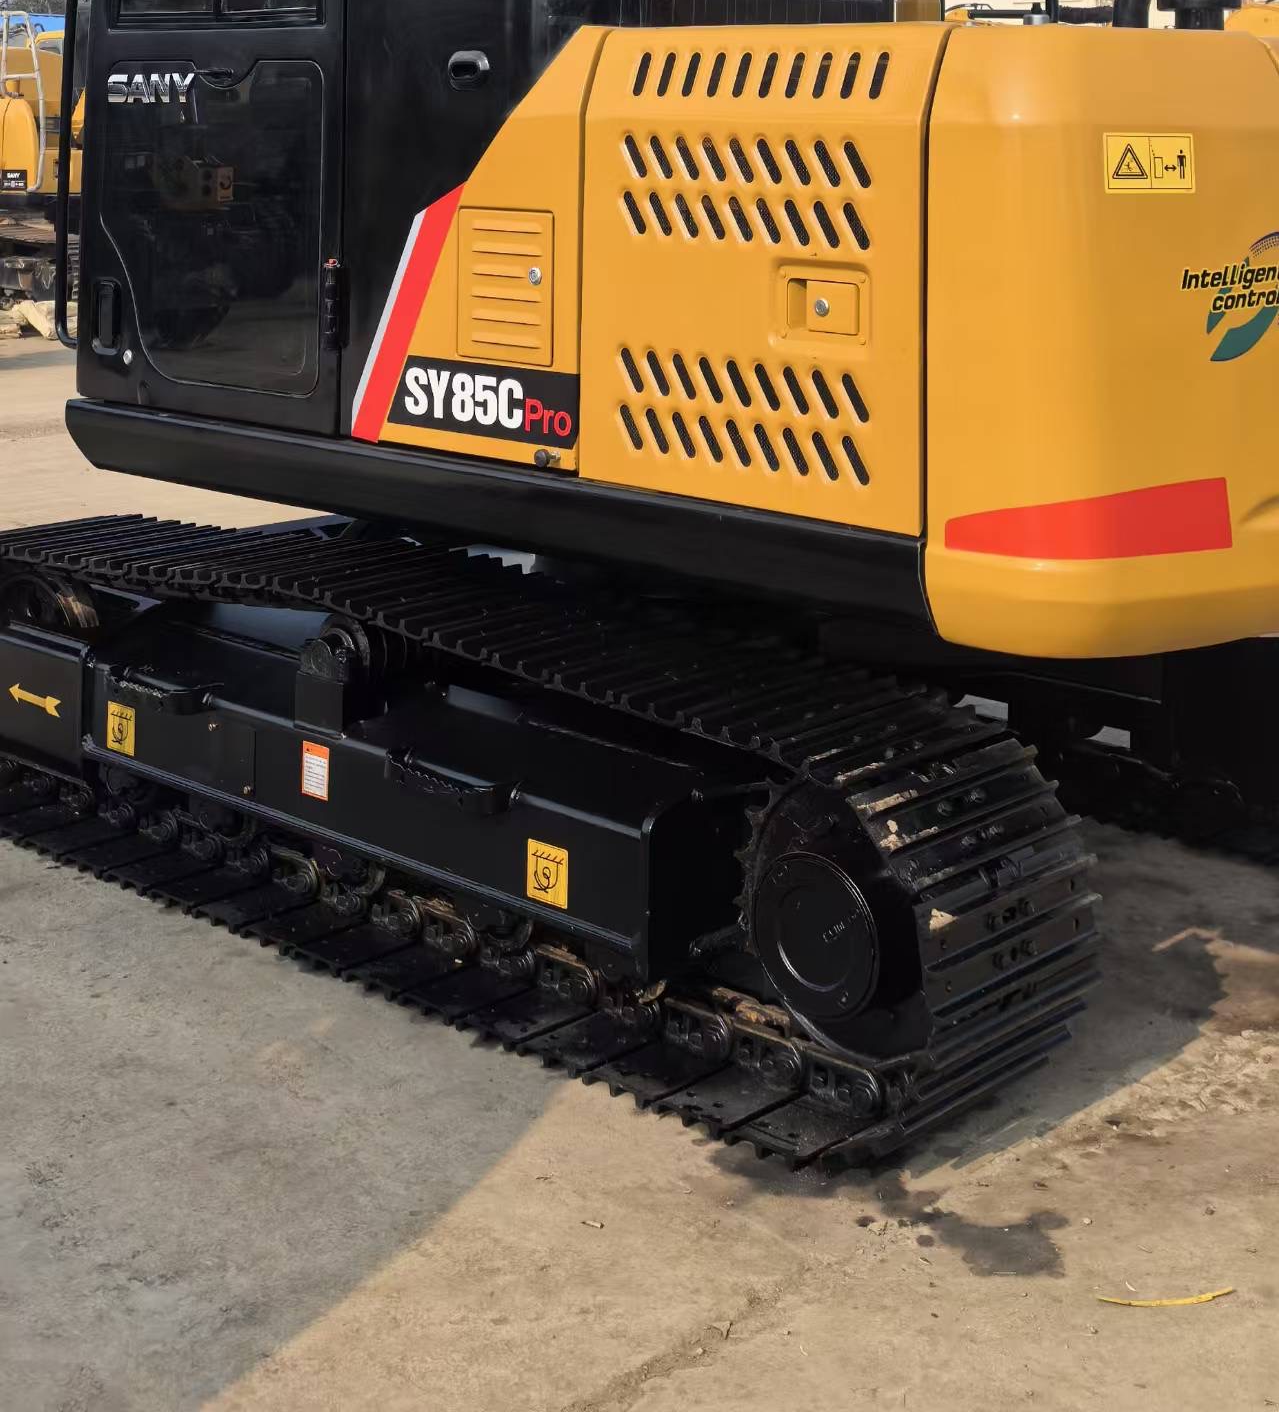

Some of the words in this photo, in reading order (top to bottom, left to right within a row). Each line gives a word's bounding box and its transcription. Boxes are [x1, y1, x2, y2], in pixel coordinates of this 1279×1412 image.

[107, 72, 195, 103] SANY
[1181, 263, 1279, 289] Intelligen
[404, 366, 524, 429] SY85C
[524, 398, 572, 437] Pro
